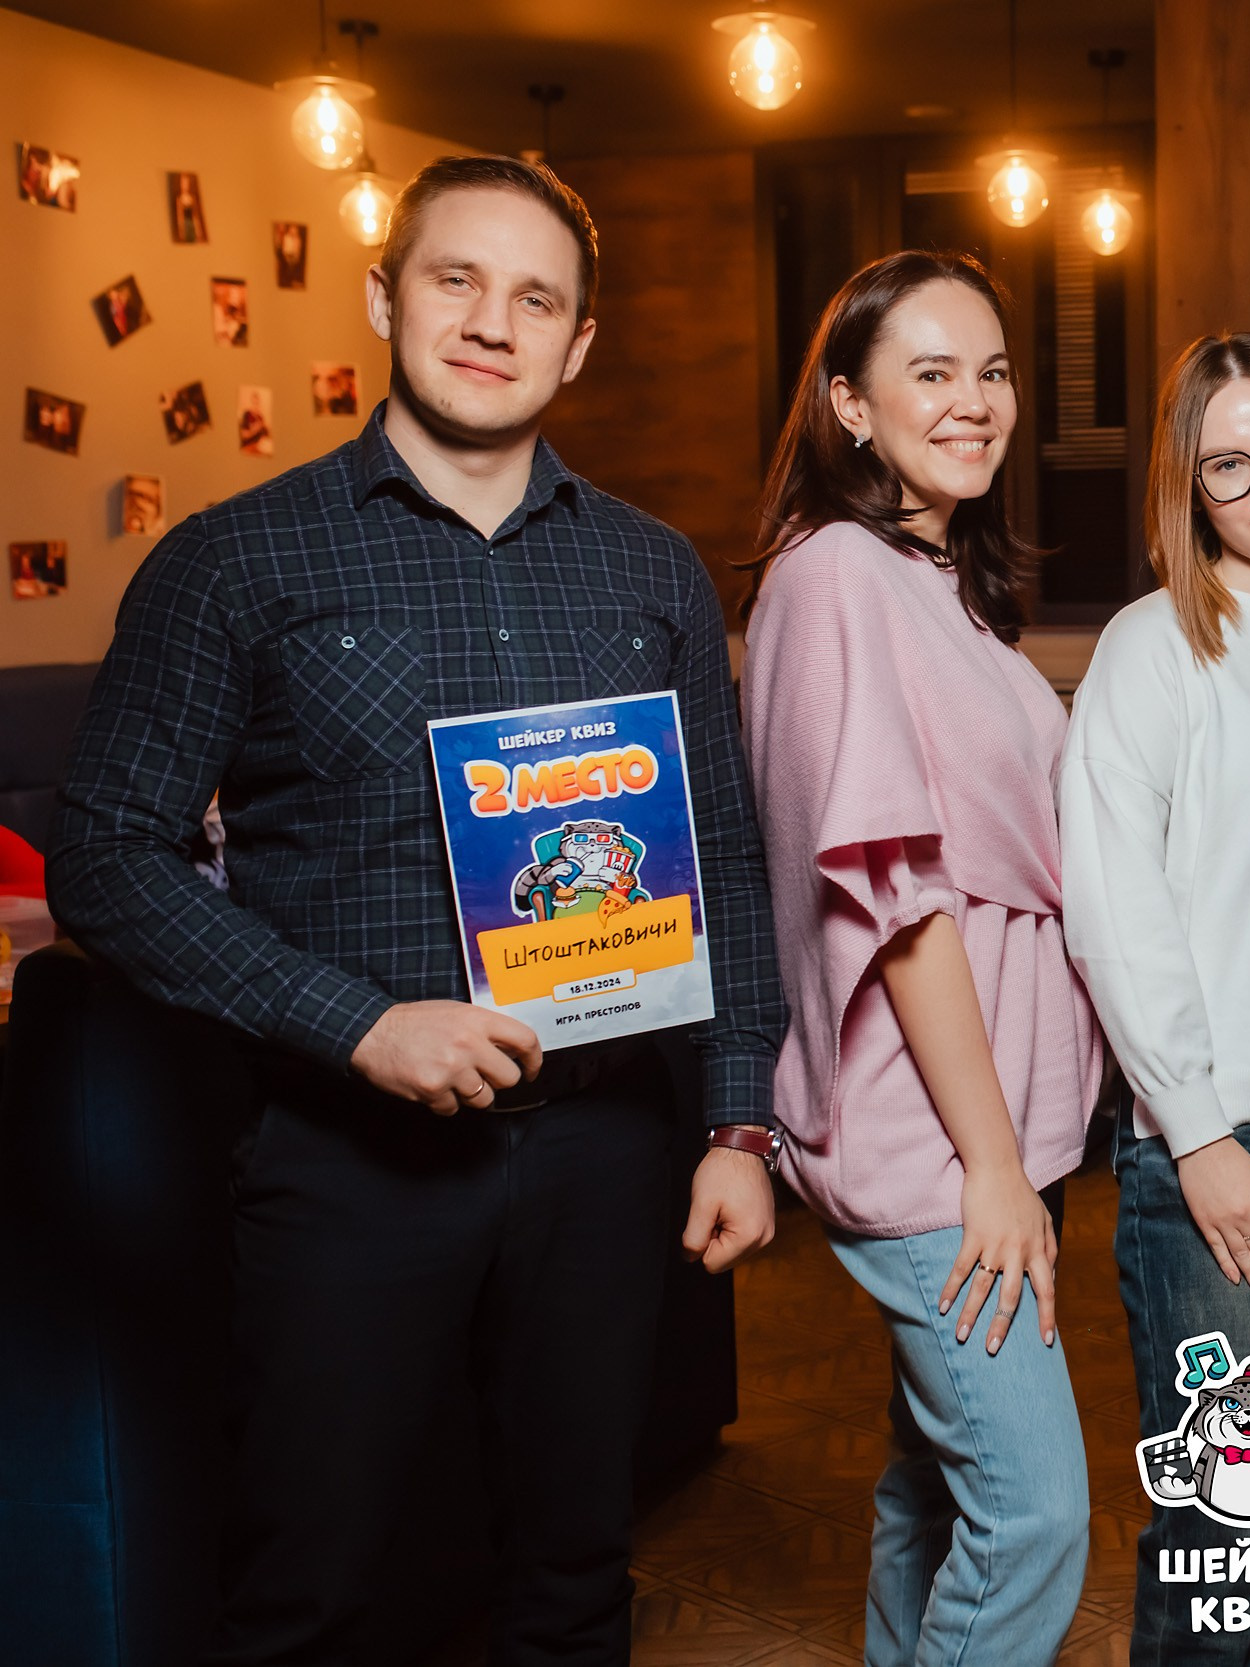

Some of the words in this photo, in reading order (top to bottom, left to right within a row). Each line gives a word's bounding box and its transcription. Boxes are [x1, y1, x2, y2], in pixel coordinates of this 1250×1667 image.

[498, 727, 566, 750] ШЕЙКЕР
[571, 721, 617, 740] КВИЗ
[466, 761, 510, 816] 2
[514, 747, 656, 810] МЕСТО
[570, 977, 621, 995] 18.12.2024
[555, 1013, 581, 1026] ИГРА
[584, 1001, 641, 1020] ПРЕСТОЛОВ
